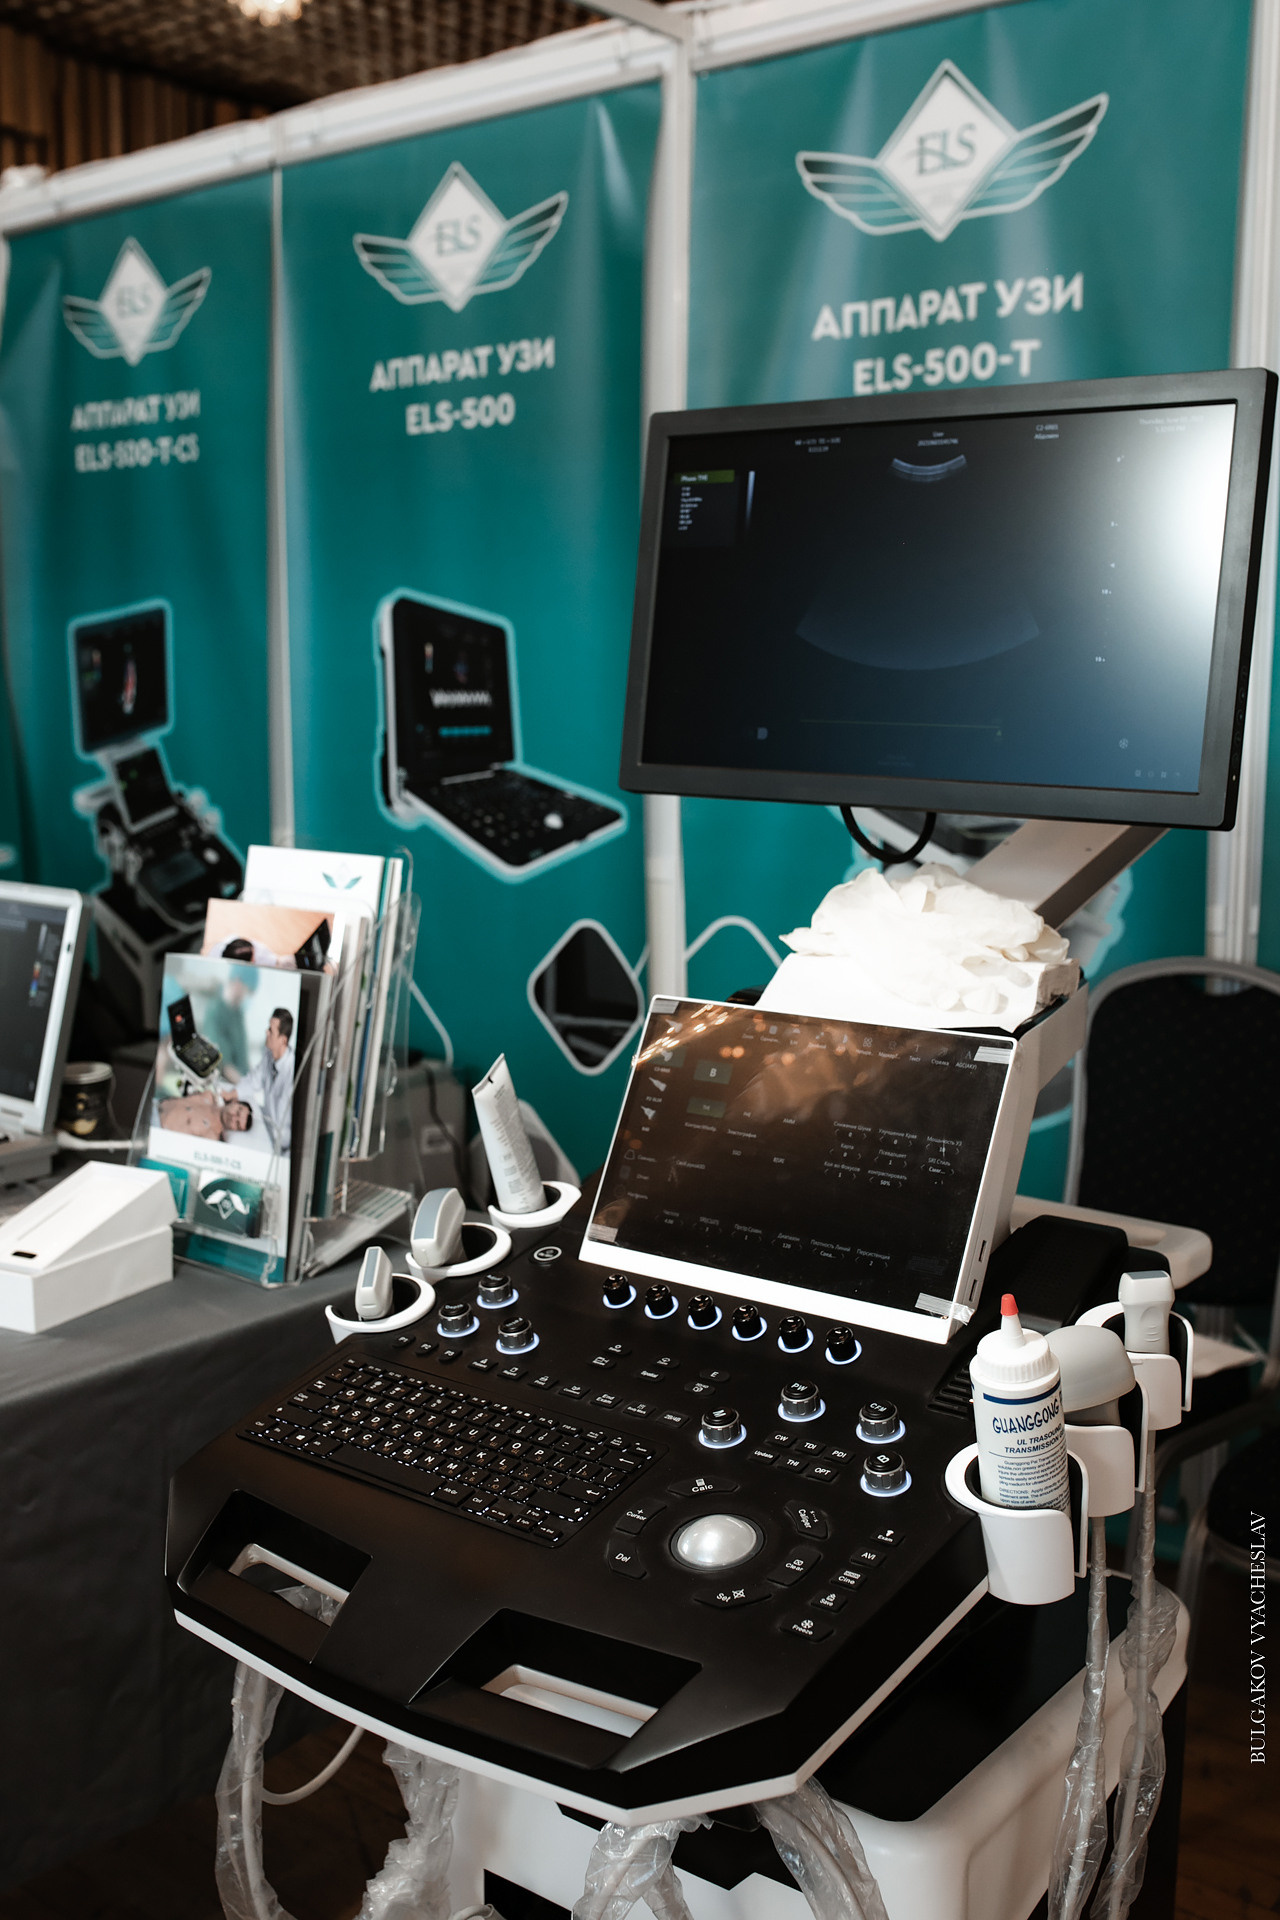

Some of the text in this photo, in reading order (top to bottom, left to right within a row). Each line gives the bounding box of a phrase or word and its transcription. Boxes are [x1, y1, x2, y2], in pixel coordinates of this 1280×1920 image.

[811, 271, 1085, 342] АППАРАТ УЗИ
[369, 335, 556, 393] АППАРАТ УЗИ
[852, 338, 1042, 396] ELS-500-T
[404, 391, 516, 436] ELS-500
[709, 1068, 718, 1078] B
[790, 1382, 808, 1392] PW
[345, 1389, 356, 1397] Q
[602, 1393, 616, 1401] End
[595, 1396, 613, 1404] Exam
[869, 1402, 887, 1413] CFM
[712, 1408, 727, 1418] M
[992, 1398, 1060, 1434] GUANGGONG
[341, 1426, 352, 1434] X
[468, 1428, 479, 1436] U
[432, 1437, 444, 1445] H
[774, 1433, 789, 1442] CW
[804, 1442, 817, 1450] TDI
[1004, 1434, 1060, 1454] TRANSMISSION
[424, 1455, 435, 1463] N
[476, 1451, 487, 1459] K
[754, 1450, 774, 1459] Update
[831, 1450, 848, 1459] PDI
[876, 1454, 890, 1464] B
[446, 1462, 458, 1470] M
[499, 1458, 507, 1466] L
[786, 1458, 800, 1467] THI
[814, 1467, 832, 1476] OPT
[691, 1484, 714, 1493] Calc
[626, 1511, 647, 1521] Cursor
[877, 1534, 894, 1542] Exam
[615, 1552, 631, 1563] Del
[861, 1552, 877, 1560] AVI
[785, 1562, 804, 1572] Clear
[838, 1575, 856, 1585] Cine
[716, 1592, 731, 1603] Set
[819, 1597, 834, 1607] Save
[792, 1624, 813, 1636] Freeze
